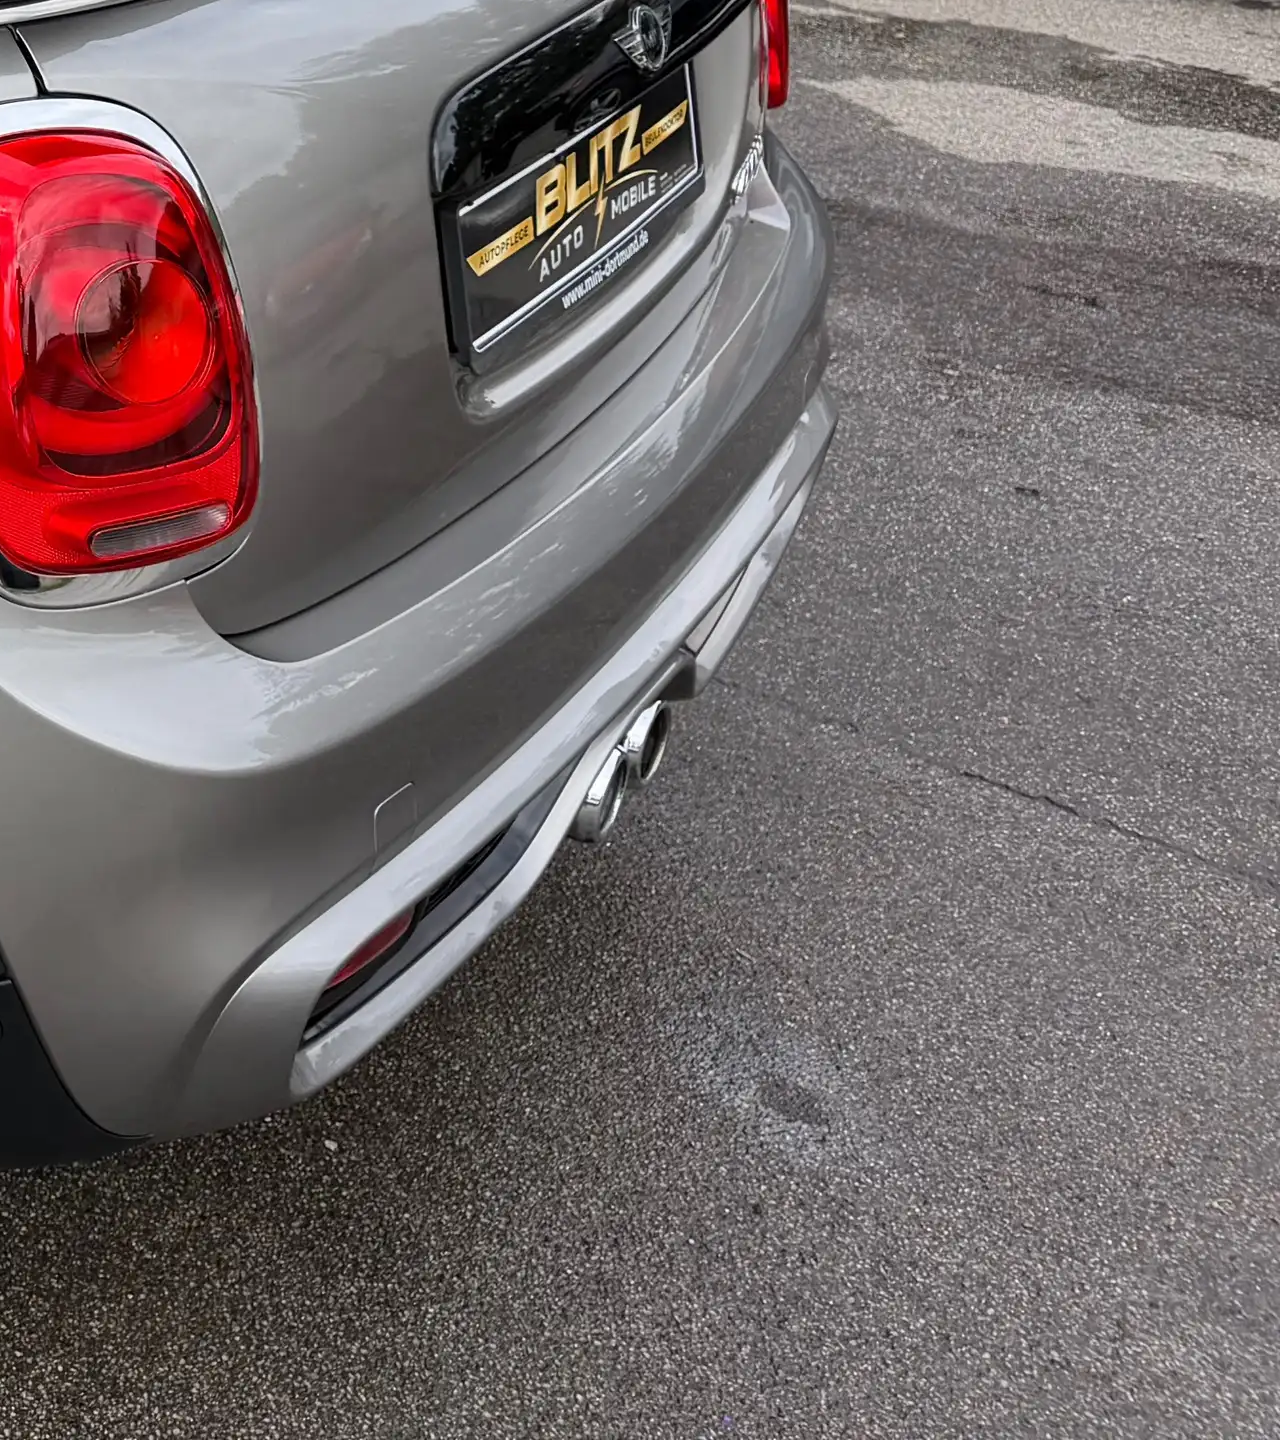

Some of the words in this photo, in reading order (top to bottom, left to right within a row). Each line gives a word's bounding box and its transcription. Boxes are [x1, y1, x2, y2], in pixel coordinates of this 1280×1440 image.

[536, 103, 642, 236] BLITZ
[478, 225, 529, 268] AUTOPFLEGE
[540, 224, 584, 282] AUTO
[611, 174, 656, 219] MOBILE
[561, 228, 649, 309] www.mini-dortmund.de
